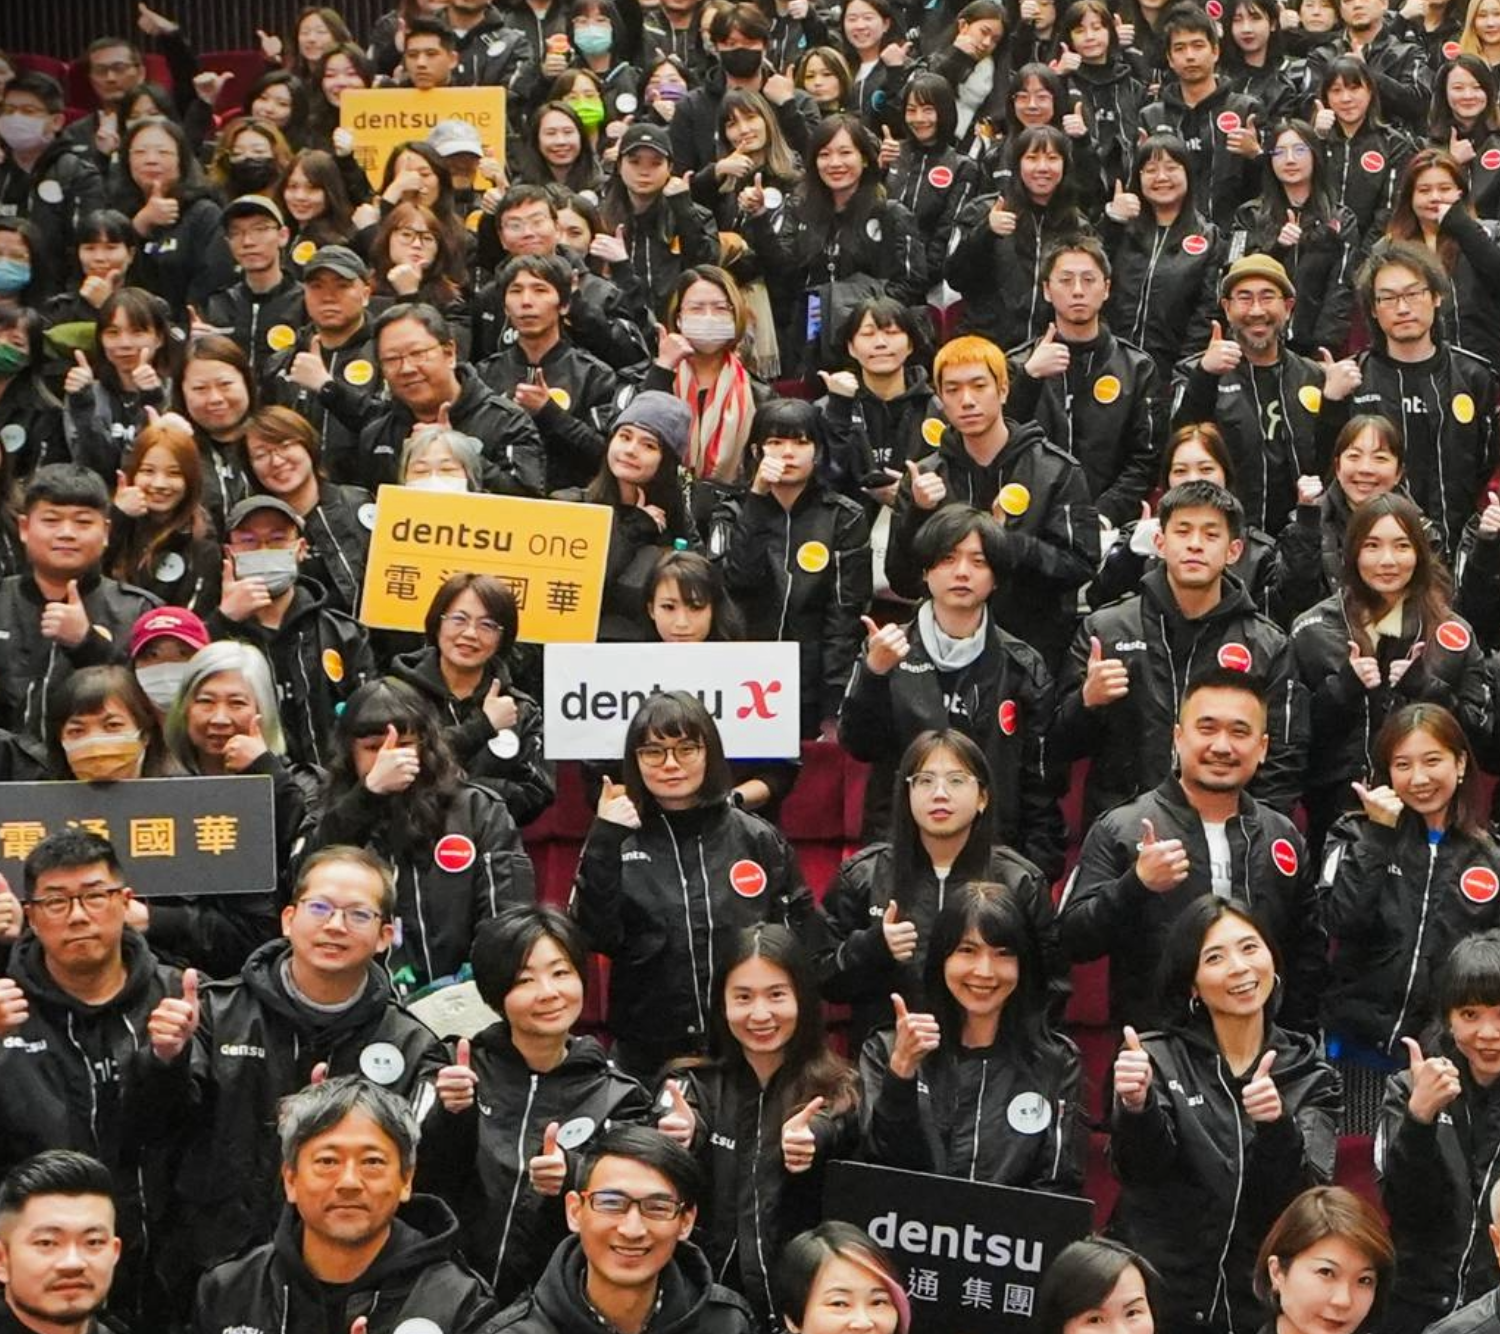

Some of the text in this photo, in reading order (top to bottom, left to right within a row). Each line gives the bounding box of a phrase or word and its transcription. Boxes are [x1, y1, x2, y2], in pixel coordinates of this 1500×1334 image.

[354, 108, 438, 130] dentsu
[392, 518, 590, 559] dentsu one
[562, 682, 725, 721] denu
[868, 1210, 1045, 1274] dentsu
[907, 1267, 1035, 1318] 通集團
